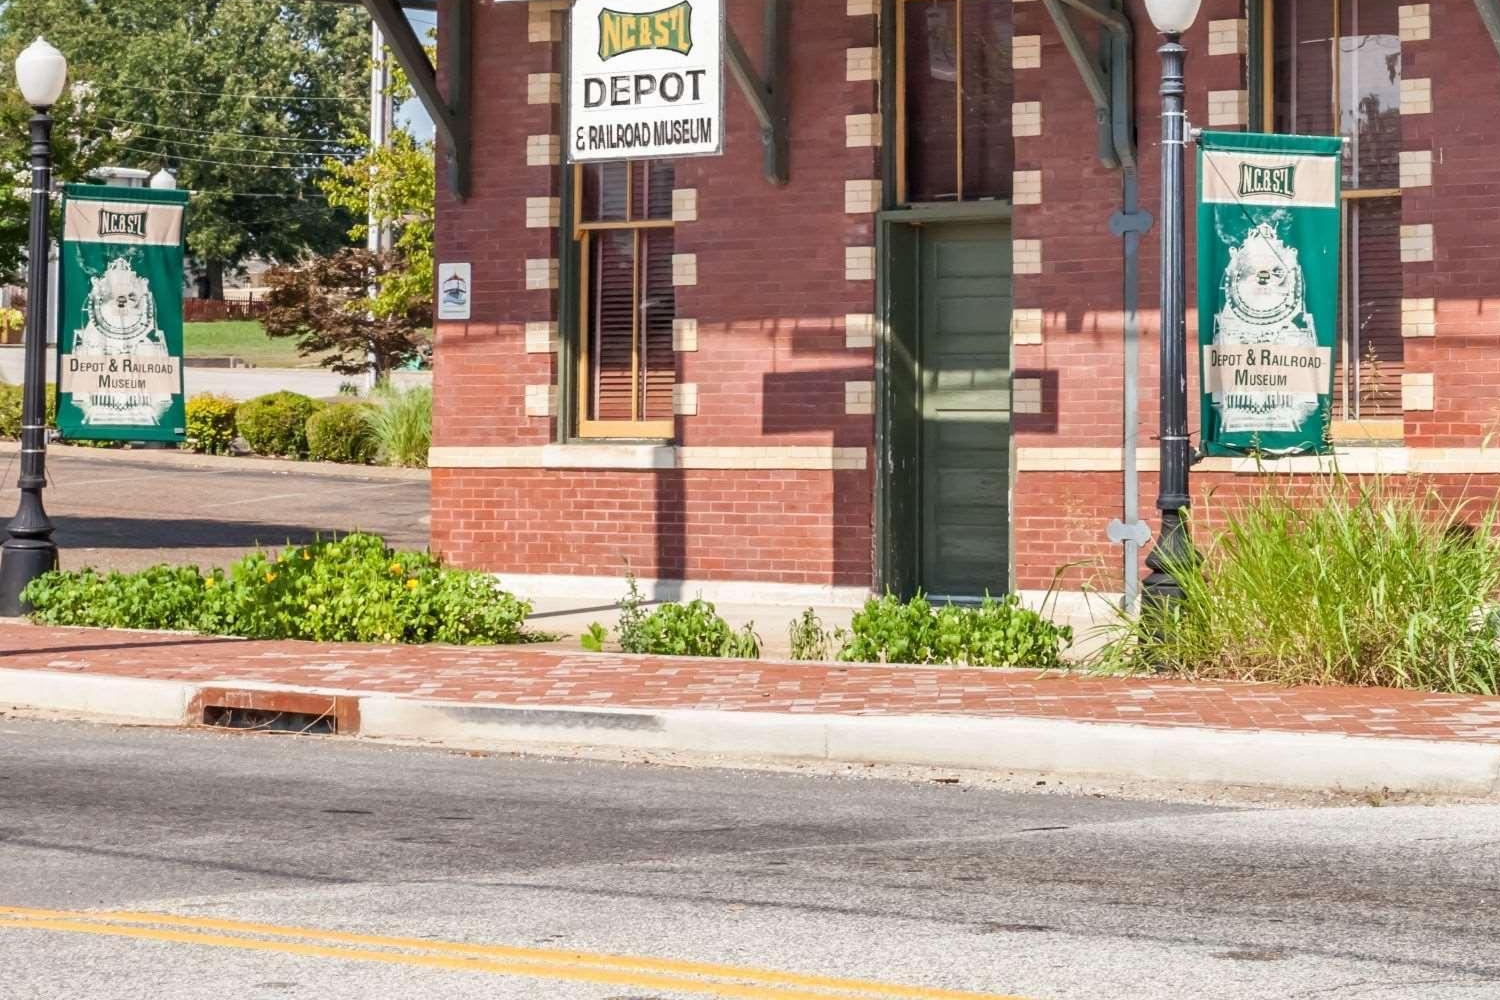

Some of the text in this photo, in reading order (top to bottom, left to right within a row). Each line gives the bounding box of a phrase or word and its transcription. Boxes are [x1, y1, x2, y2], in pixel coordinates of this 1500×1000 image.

[583, 69, 706, 109] DEPOT
[576, 117, 712, 151] & RAILROAD MUSEUM
[70, 358, 174, 374] DEPOT & RAILROAD
[1211, 349, 1321, 368] DEPOT & RAILROAD
[98, 374, 146, 389] MUSEUM
[1234, 369, 1287, 386] MUSEUM
